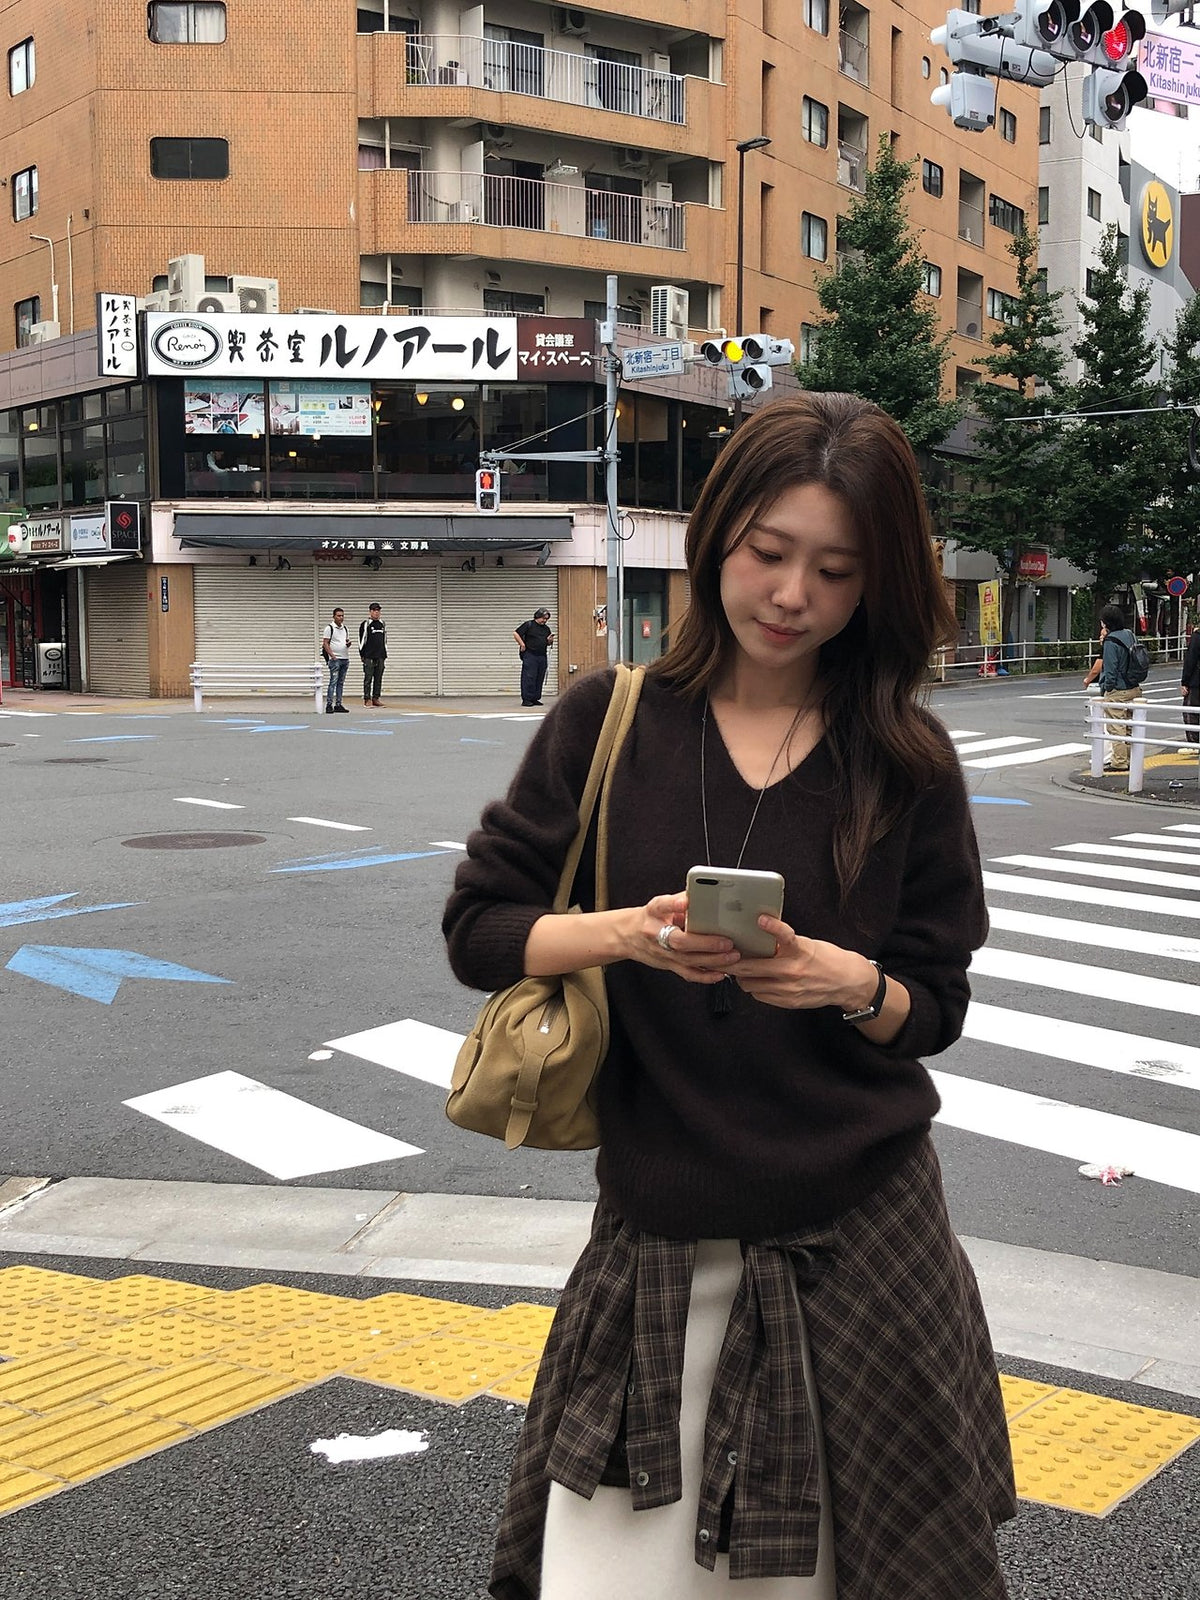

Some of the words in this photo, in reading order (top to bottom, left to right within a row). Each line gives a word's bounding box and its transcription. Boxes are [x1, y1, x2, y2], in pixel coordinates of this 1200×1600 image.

[106, 299, 121, 369] ルノアール
[228, 327, 305, 363] 喫茶室
[320, 325, 512, 370] ルノアール
[518, 350, 592, 366] マイ・スペース
[112, 530, 138, 539] SPACE
[322, 540, 375, 550] オフィス用品
[400, 541, 429, 550] 文房具
